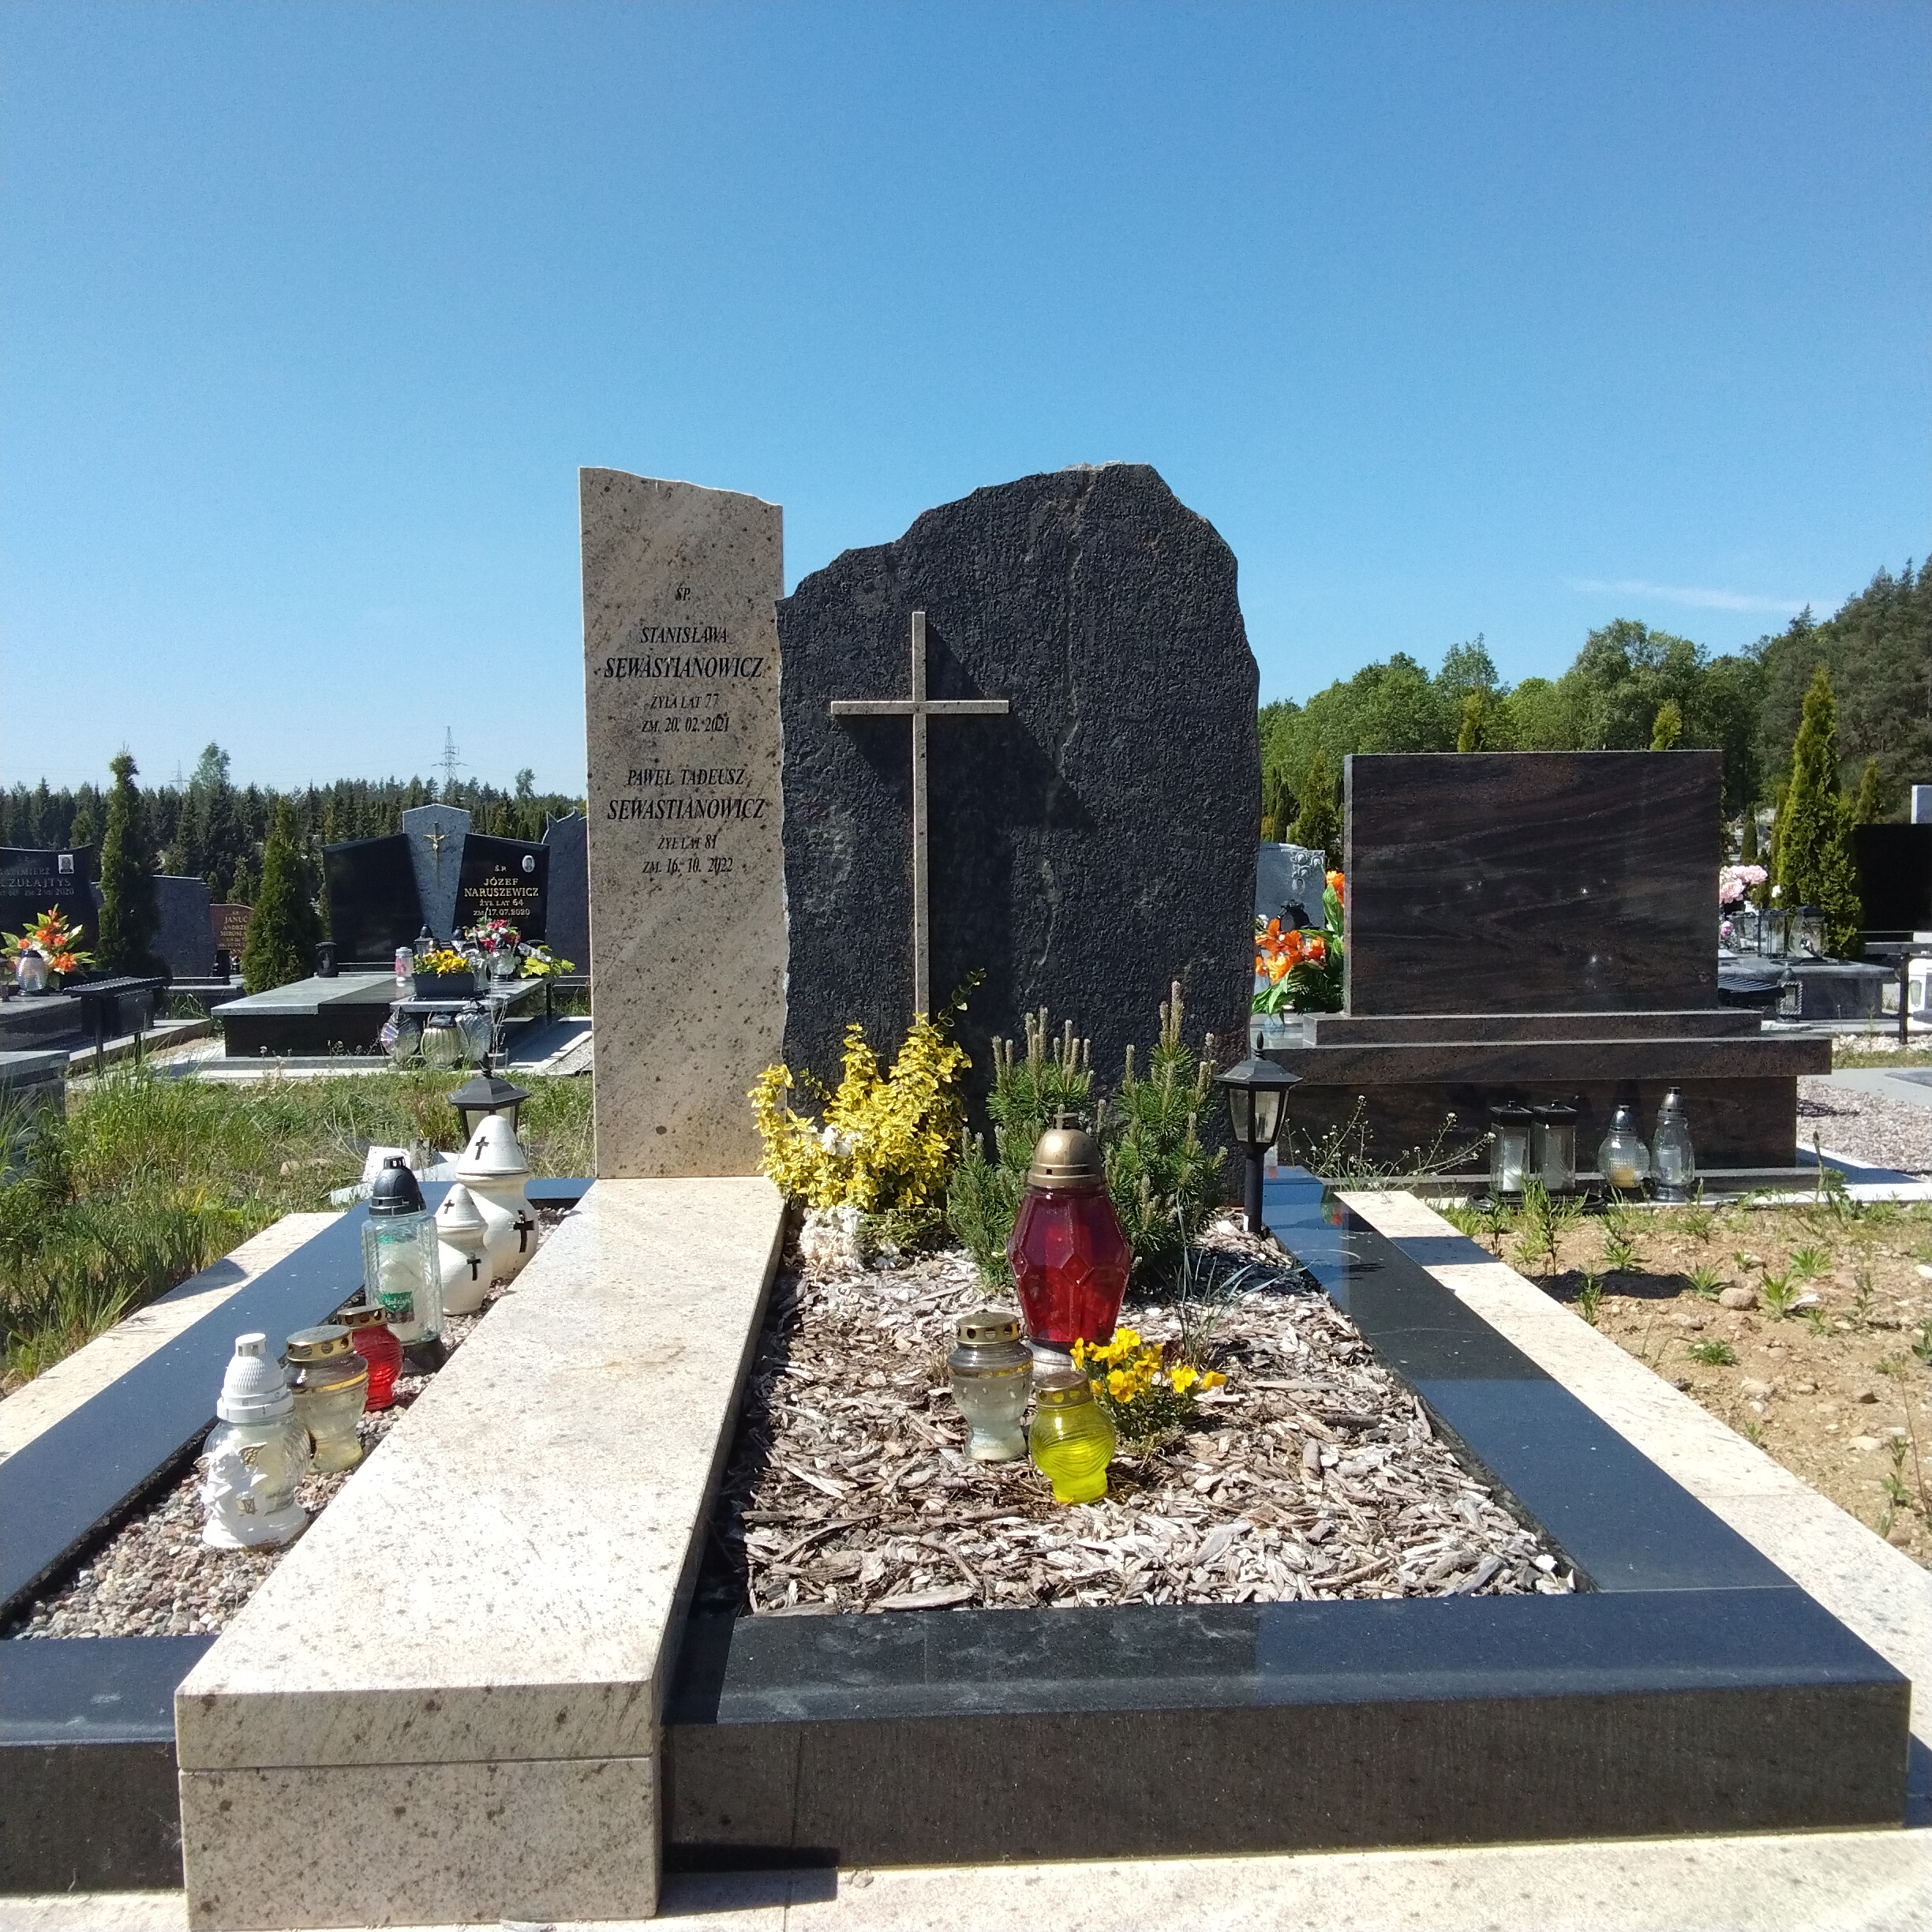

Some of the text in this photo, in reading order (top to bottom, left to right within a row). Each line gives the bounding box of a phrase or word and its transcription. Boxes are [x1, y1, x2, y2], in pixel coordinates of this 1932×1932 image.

[640, 627, 728, 643] STANISŁAWA
[604, 657, 764, 679] SEWASTIANOWICZ
[650, 693, 720, 710] ŻYŁA LAT 77
[641, 720, 661, 732] ZM.
[685, 717, 700, 732] 02.
[704, 717, 730, 732] 2021
[627, 768, 745, 786] PAWEŁ TADEUSZ
[607, 799, 766, 819] SEWASTIANOWICZ
[657, 834, 717, 850] ŻYŁ LAT 81
[642, 861, 662, 874] ZM.
[687, 858, 702, 873] 10.
[707, 857, 733, 873] 2022
[483, 876, 519, 886] JÓZEF
[464, 887, 539, 897] NARUSZEWICZ
